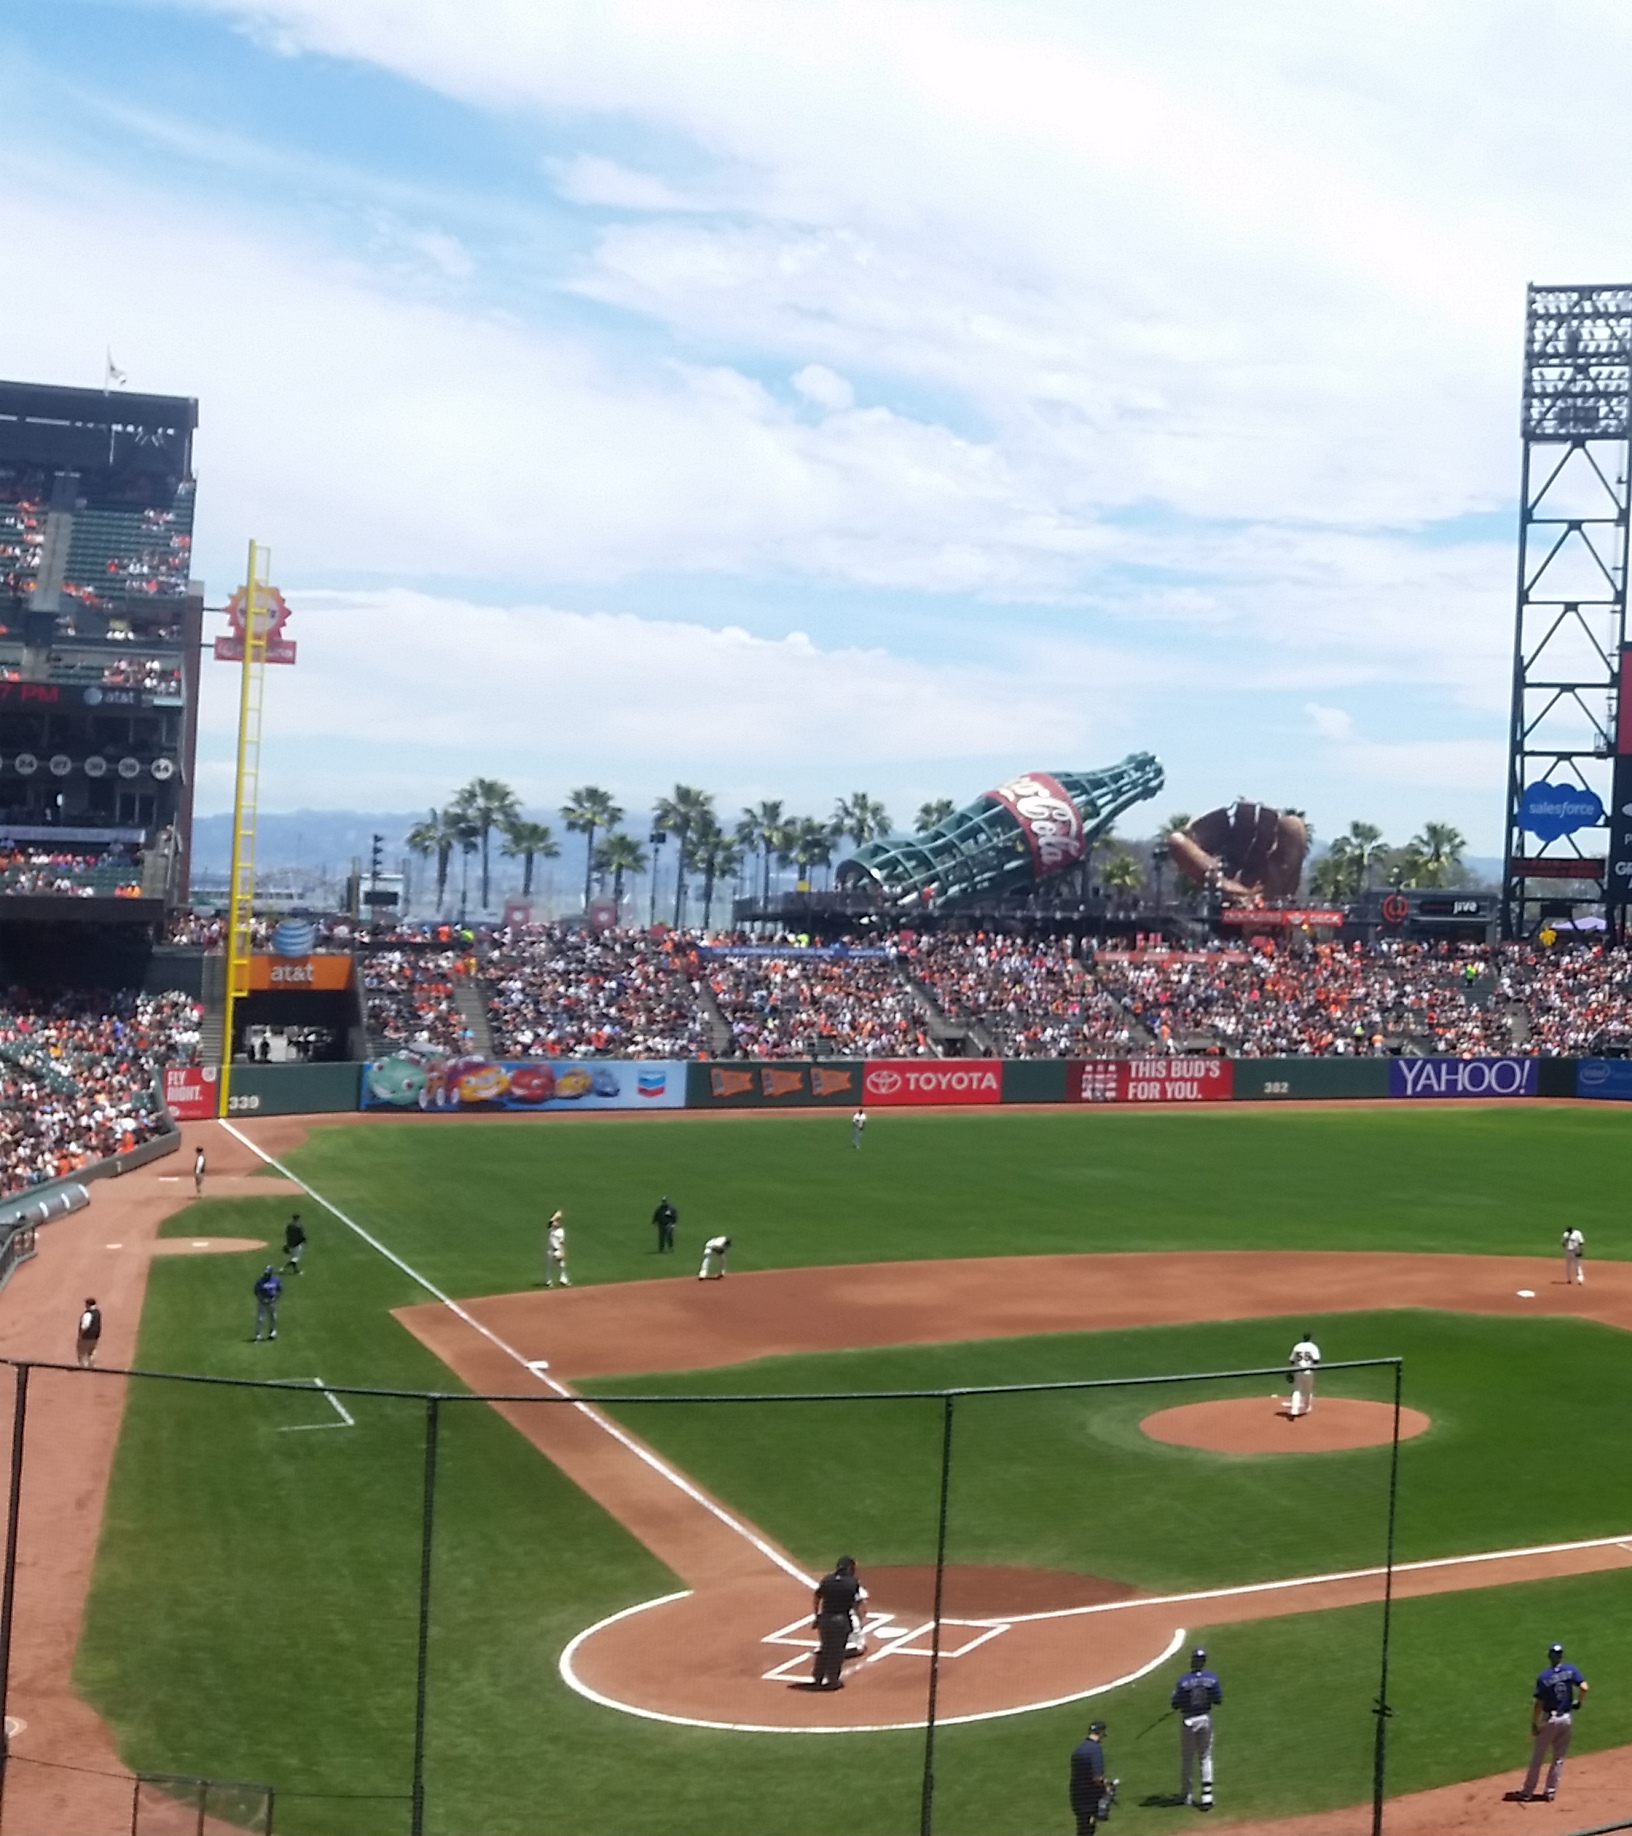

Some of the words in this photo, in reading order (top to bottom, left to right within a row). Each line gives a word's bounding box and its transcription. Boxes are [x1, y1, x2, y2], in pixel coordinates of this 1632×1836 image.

[21, 686, 58, 701] PM
[105, 691, 135, 704] at&t
[1529, 801, 1595, 818] salesforce
[1309, 914, 1340, 924] DECK
[271, 963, 315, 982] at&t
[1129, 1060, 1168, 1078] THIS
[1170, 1061, 1220, 1078] BUD'S
[168, 1070, 186, 1086] FLY
[906, 1072, 998, 1091] TOYOTA
[1398, 1059, 1531, 1096] YAHOO!
[1128, 1082, 1160, 1100] FOR
[1164, 1082, 1202, 1100] YOU.
[1264, 1082, 1290, 1094] 382
[228, 1096, 259, 1110] 339
